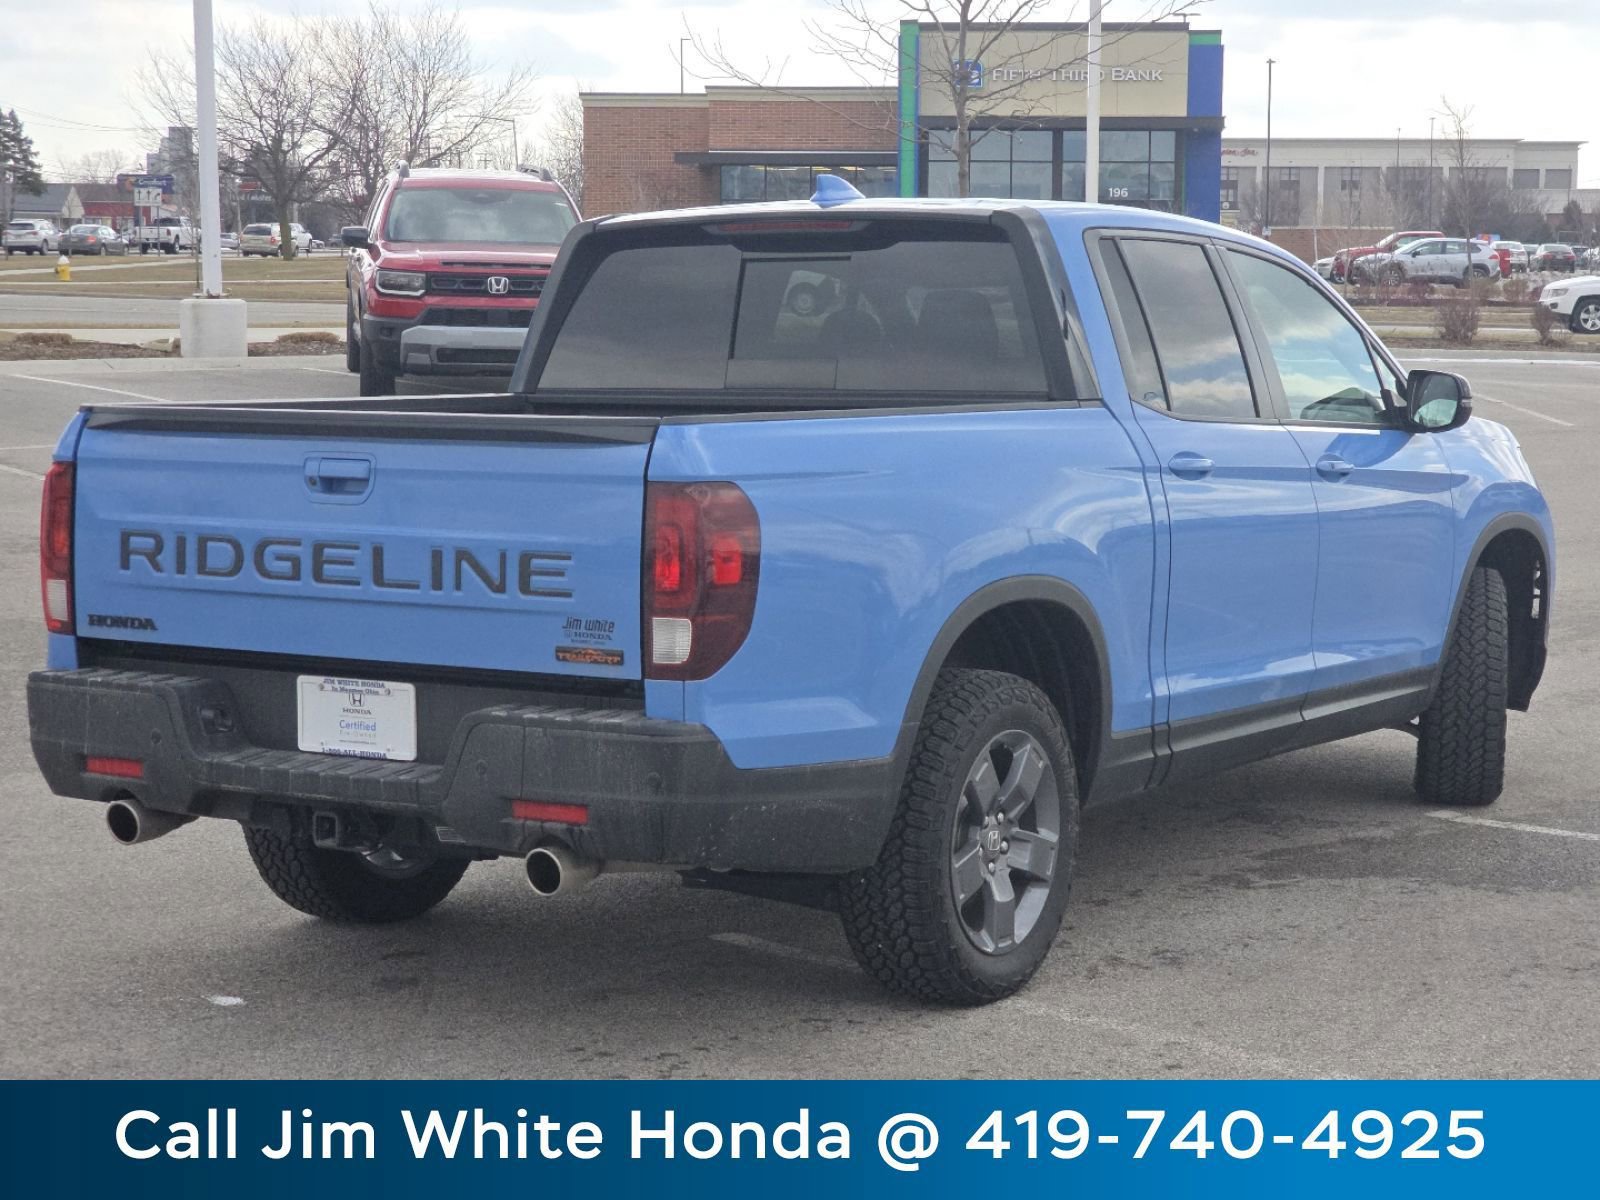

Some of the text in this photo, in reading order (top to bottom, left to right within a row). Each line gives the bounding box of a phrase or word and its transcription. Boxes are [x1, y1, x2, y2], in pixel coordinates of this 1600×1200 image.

[992, 68, 1041, 81] FIFTH
[1111, 67, 1163, 81] BANK
[1108, 187, 1129, 198] 196
[119, 529, 574, 599] RIDGELINE
[87, 613, 158, 630] HONDA
[562, 615, 582, 630] Jim
[574, 631, 613, 641] HONDA
[337, 679, 360, 687] WHITE
[361, 681, 385, 689] HONDA
[342, 707, 372, 715] HONDA
[339, 719, 376, 732] Certified
